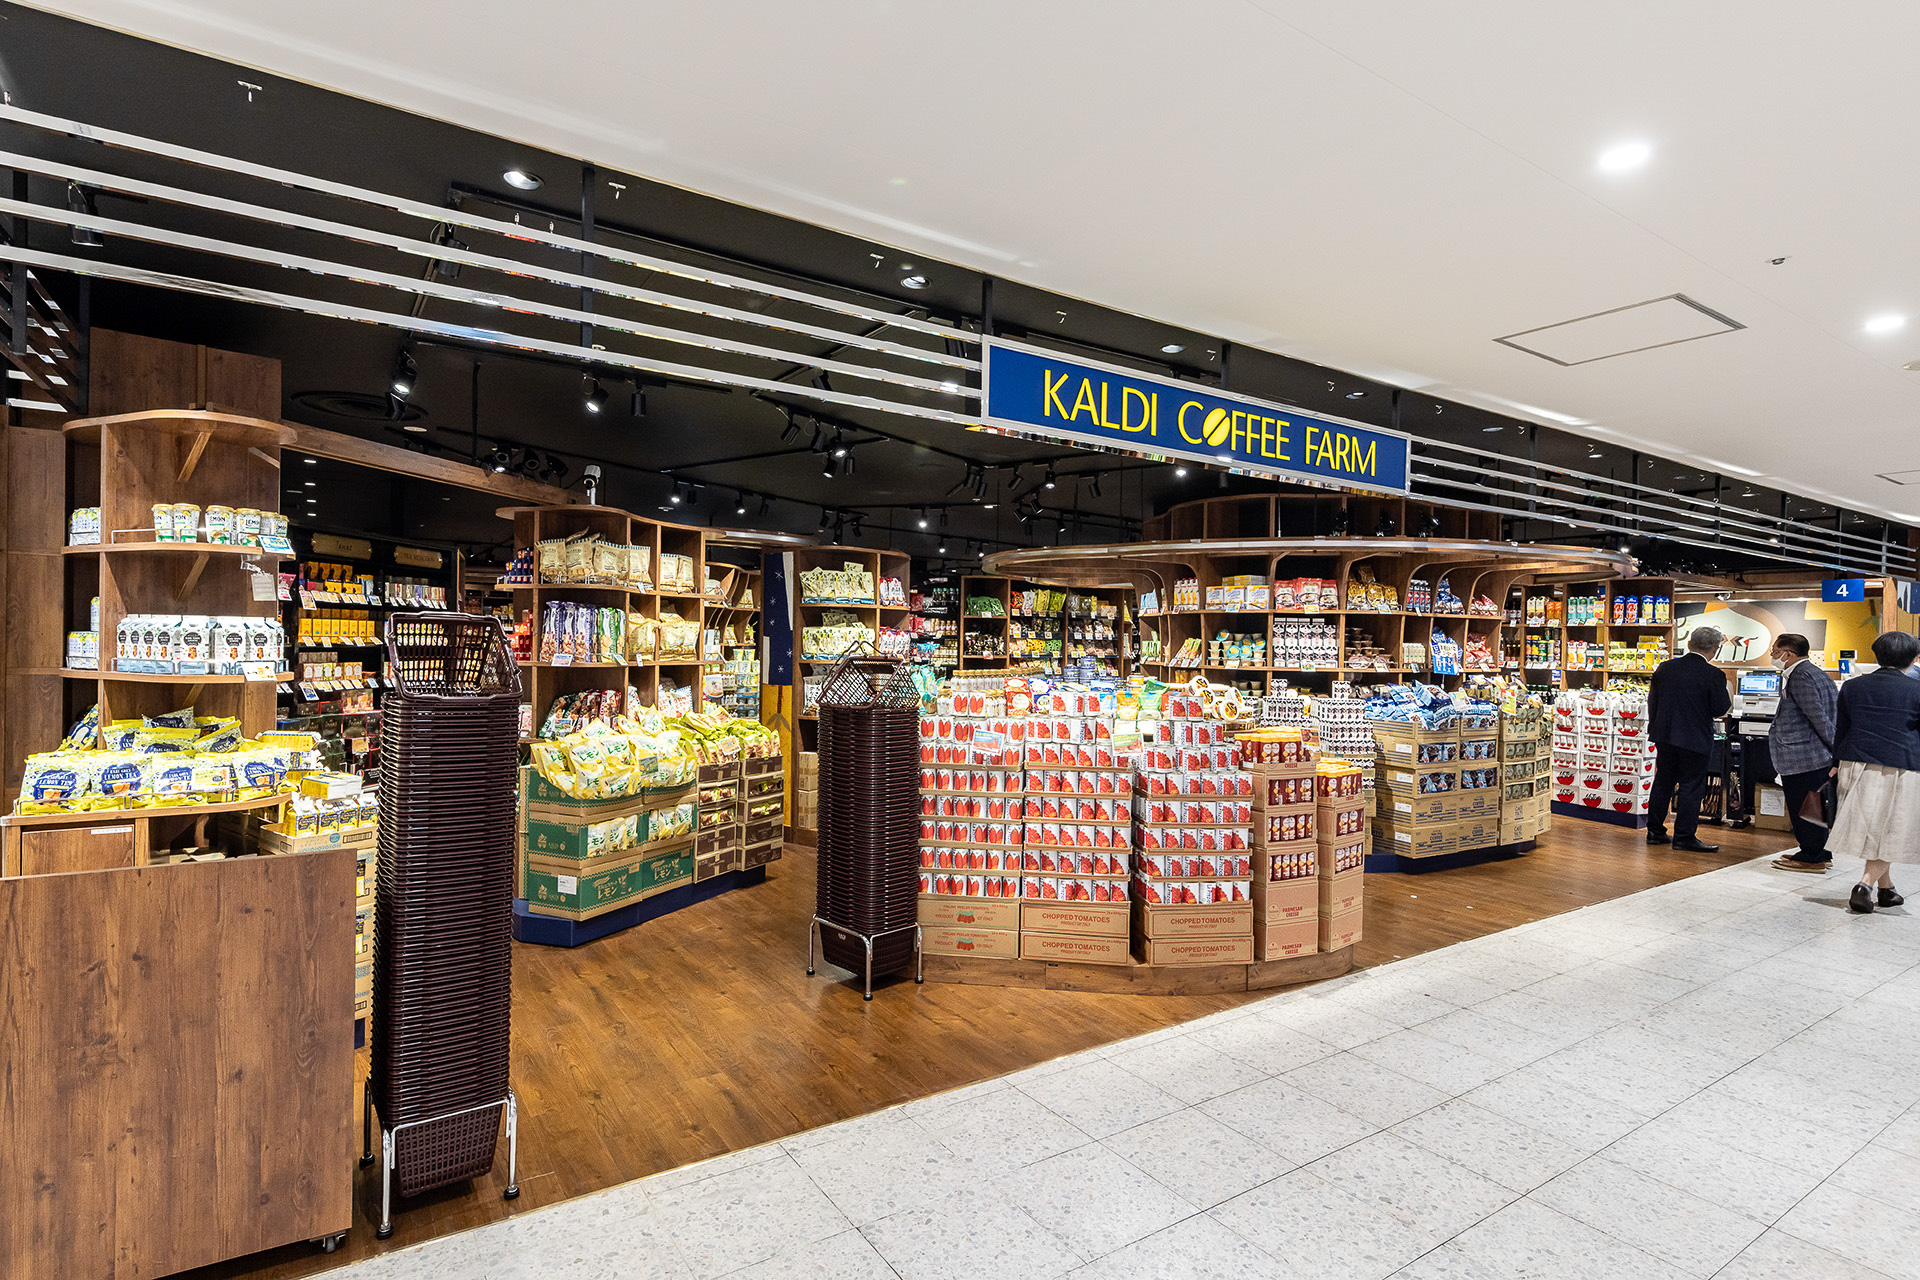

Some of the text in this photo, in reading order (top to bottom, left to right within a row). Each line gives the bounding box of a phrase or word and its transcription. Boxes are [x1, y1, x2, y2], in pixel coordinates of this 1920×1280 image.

[1043, 369, 1377, 477] KALDI COFFEE FARM
[1836, 584, 1849, 597] 4
[654, 869, 671, 880] レモン
[598, 886, 617, 899] レモン
[1074, 915, 1110, 923] TOMATOES
[1170, 917, 1201, 925] CHOPPED
[1042, 941, 1110, 952] CHOPPED TOMATOES
[1171, 946, 1201, 954] CHOPPED
